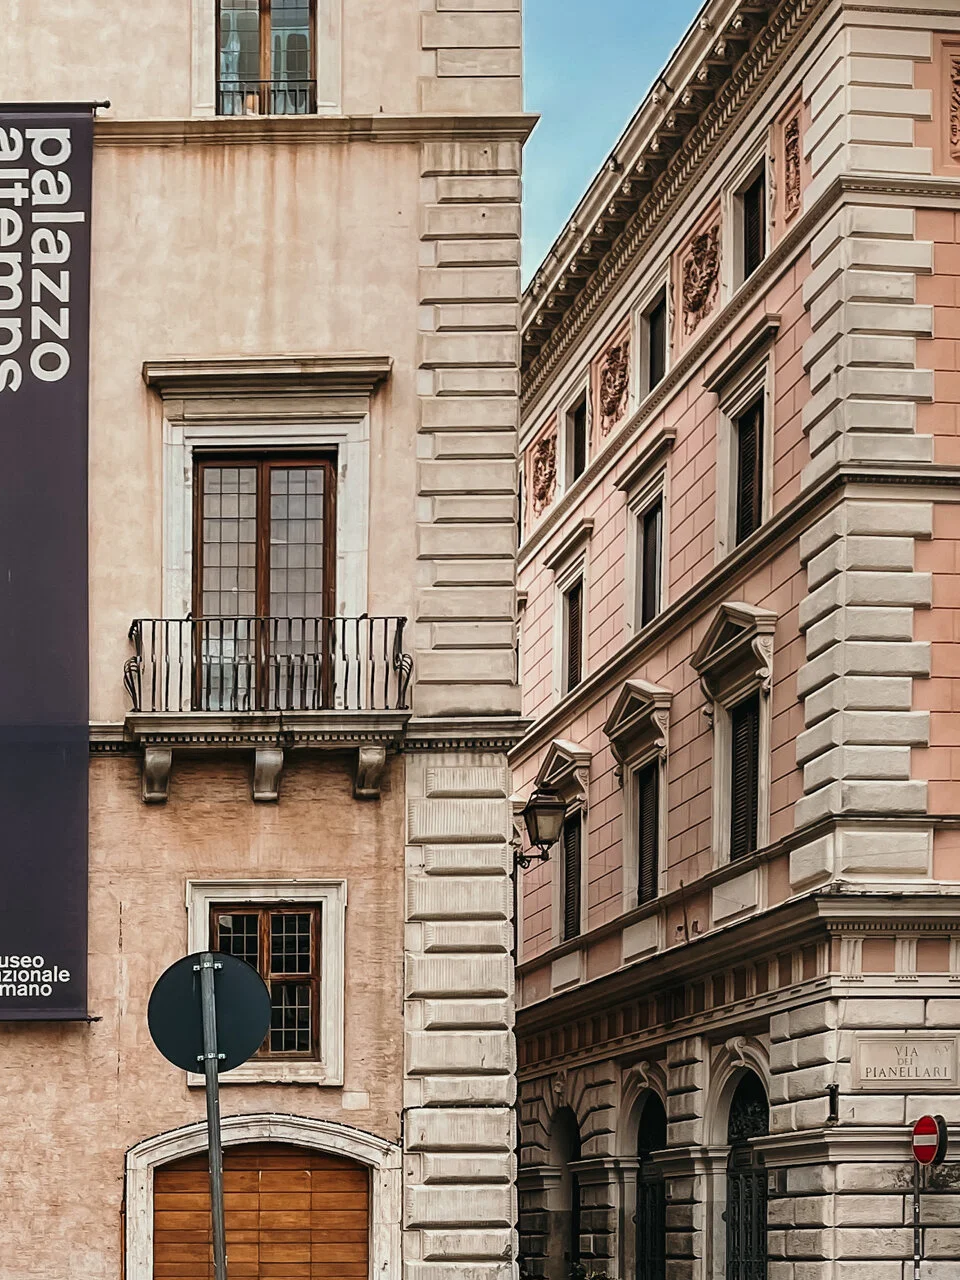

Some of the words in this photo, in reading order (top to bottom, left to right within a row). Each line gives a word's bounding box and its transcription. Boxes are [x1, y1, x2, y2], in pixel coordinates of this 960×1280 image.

[25, 128, 85, 382] palazzo
[894, 1045, 919, 1057] VIA
[897, 1057, 913, 1066] DEI
[865, 1066, 948, 1078] PIANELLARI
